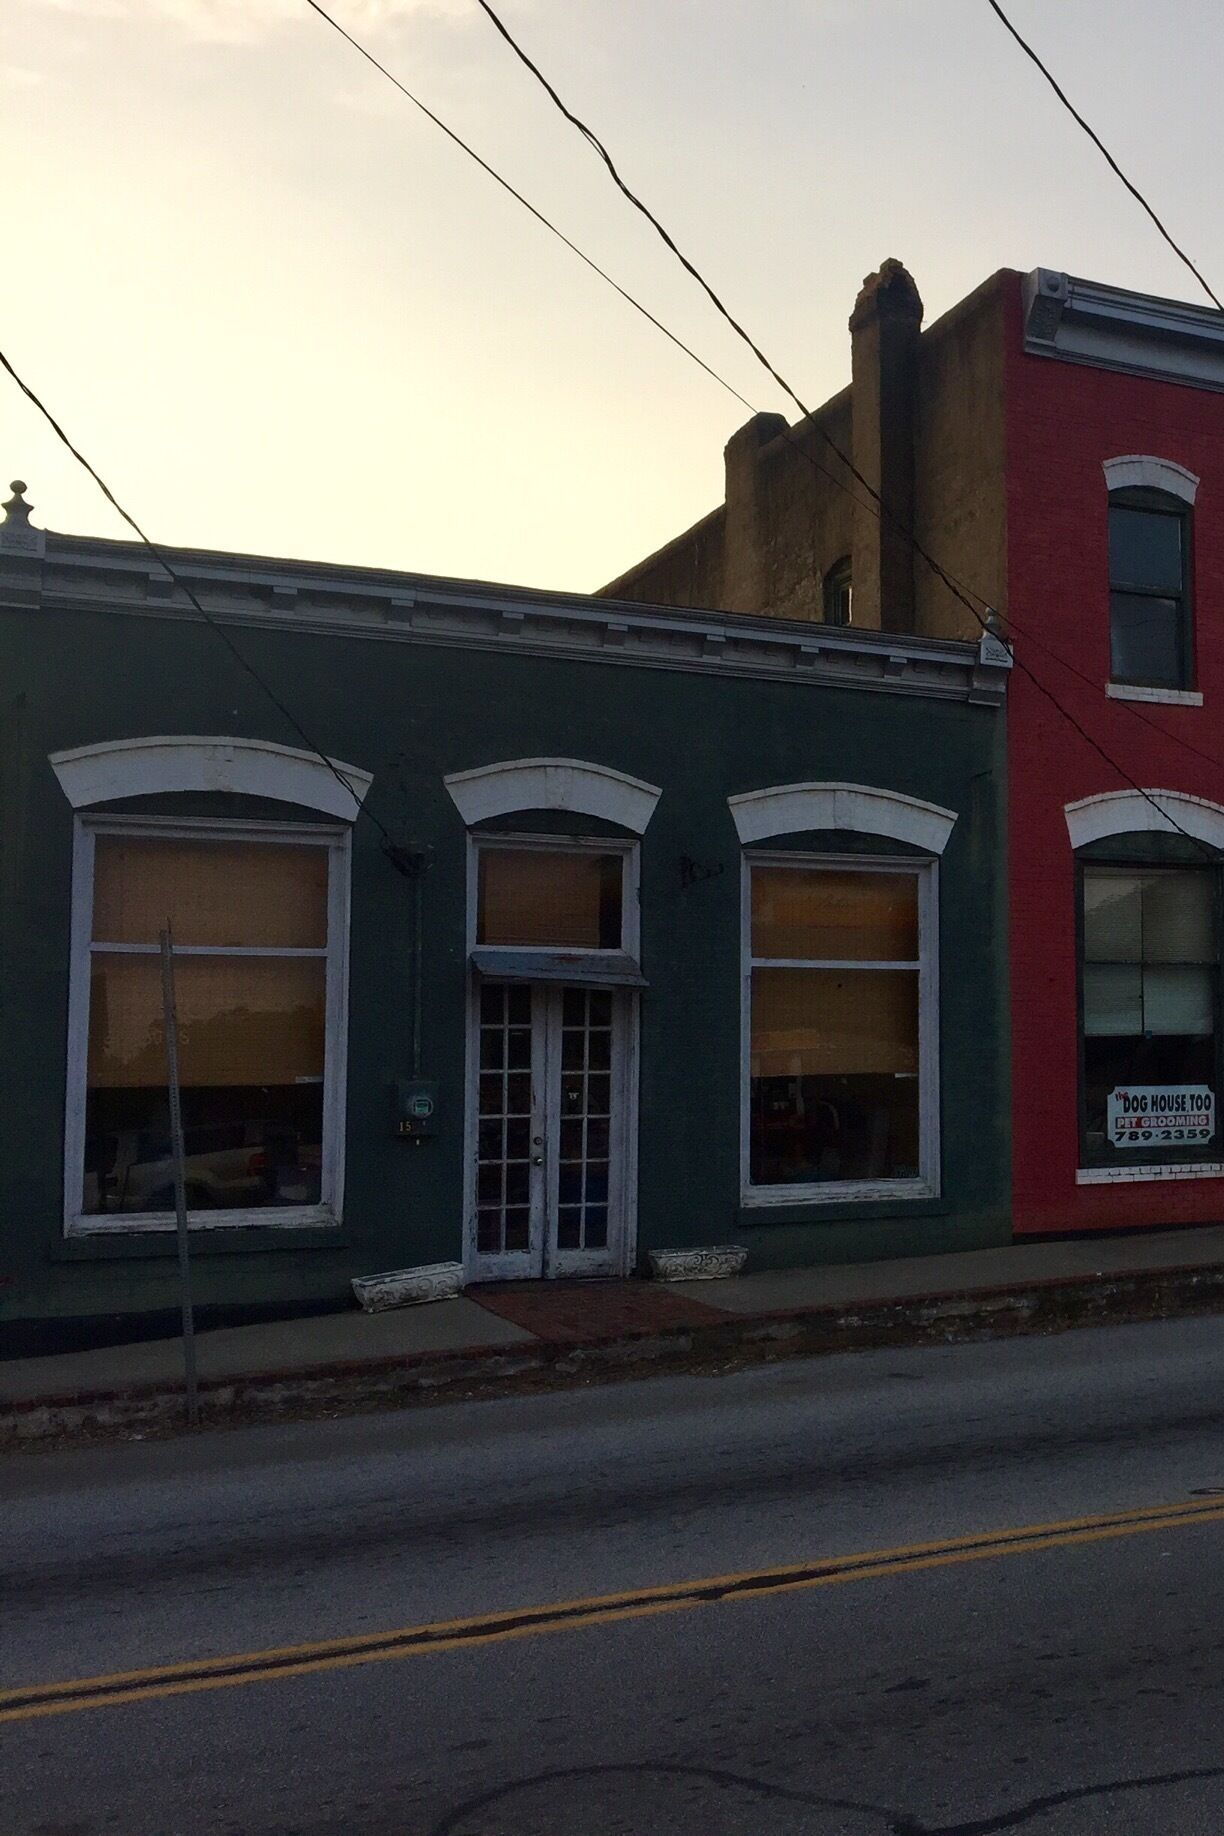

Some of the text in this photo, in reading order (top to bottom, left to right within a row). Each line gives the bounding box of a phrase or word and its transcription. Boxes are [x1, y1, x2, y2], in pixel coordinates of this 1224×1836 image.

[1123, 1093, 1212, 1113] DOG HOUSE TOO
[1117, 1115, 1208, 1128] PET GROOMING
